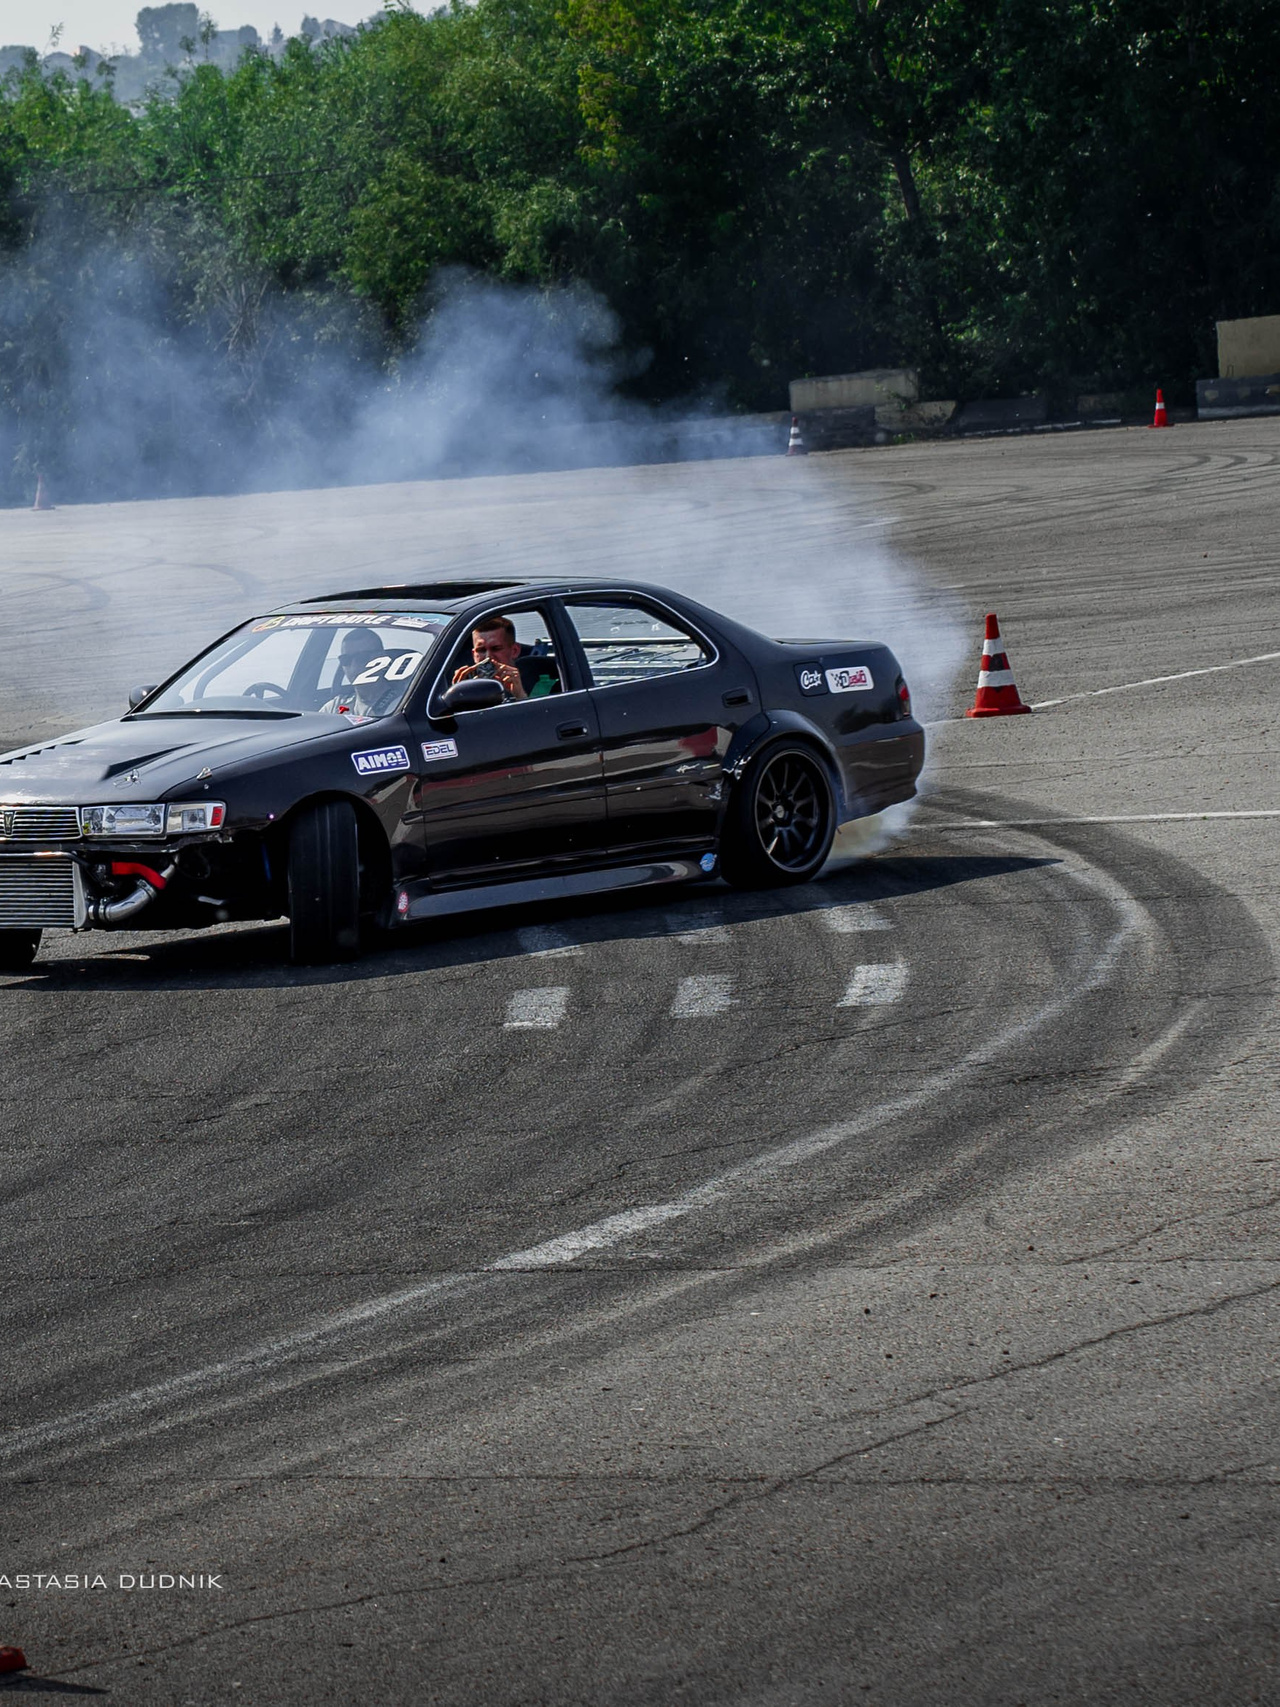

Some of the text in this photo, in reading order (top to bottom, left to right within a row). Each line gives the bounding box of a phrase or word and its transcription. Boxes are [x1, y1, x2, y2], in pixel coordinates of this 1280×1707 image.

[352, 652, 424, 685] 20
[425, 743, 454, 756] EDEL
[358, 750, 407, 770] AIMOL
